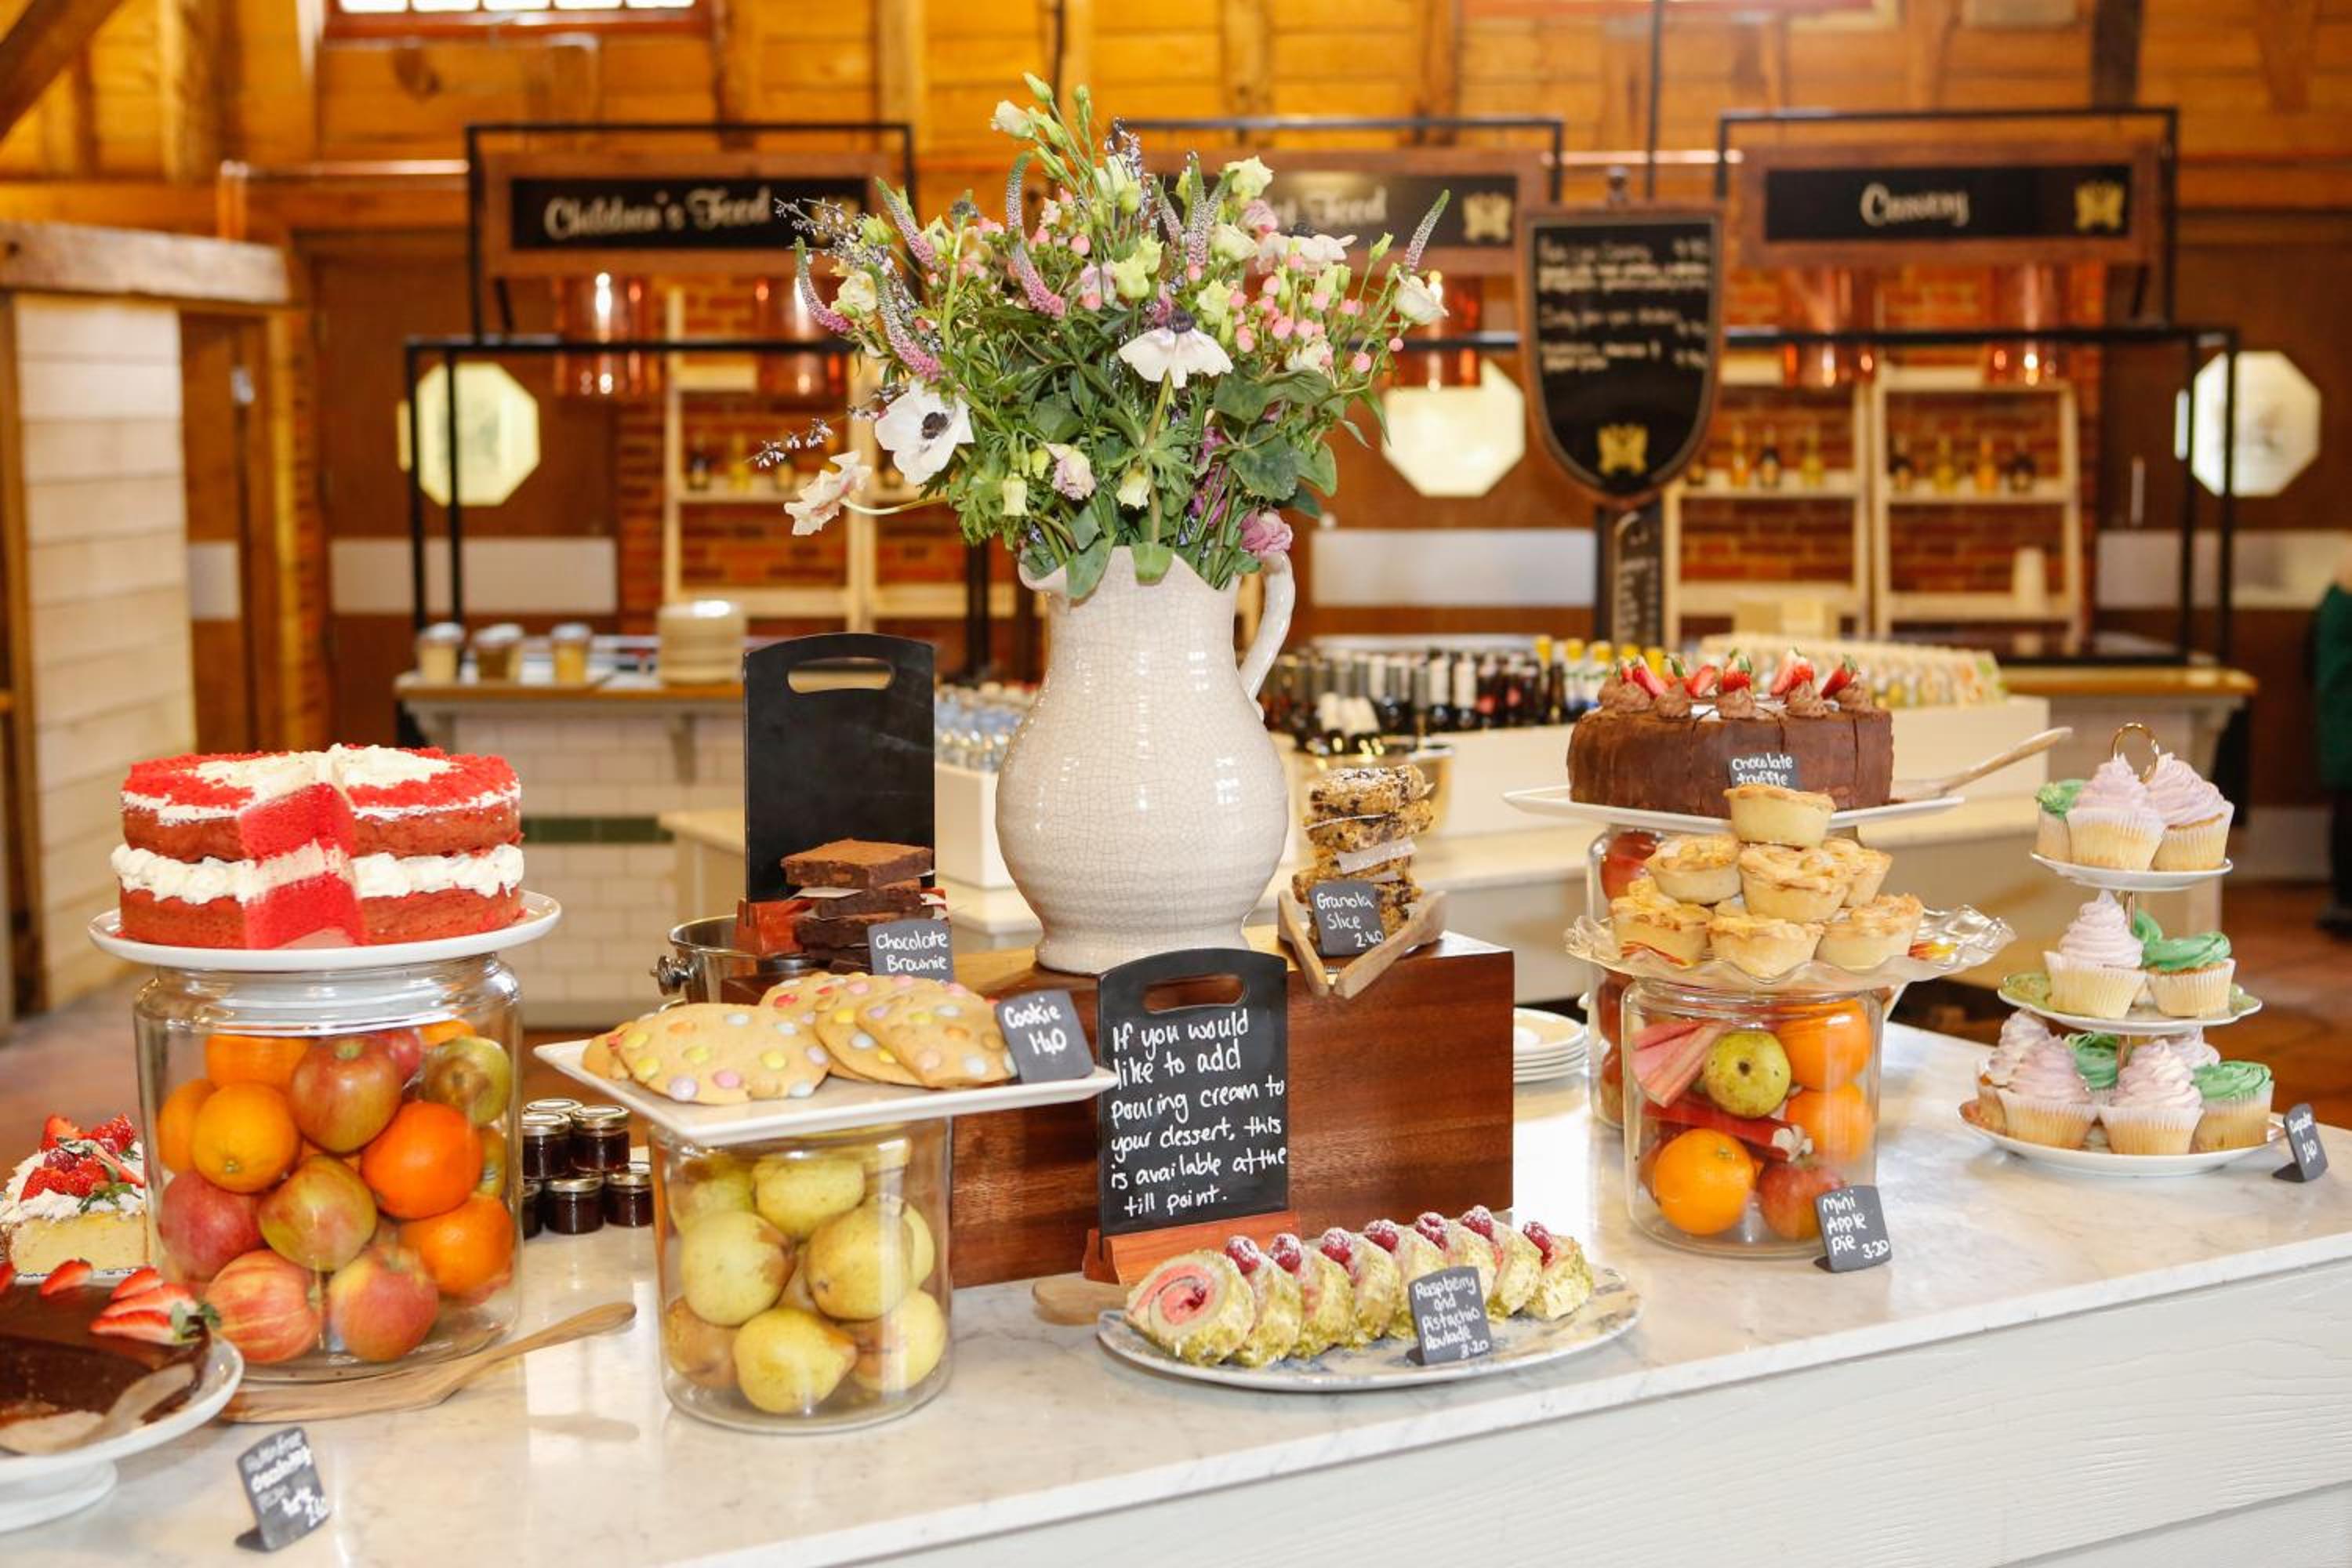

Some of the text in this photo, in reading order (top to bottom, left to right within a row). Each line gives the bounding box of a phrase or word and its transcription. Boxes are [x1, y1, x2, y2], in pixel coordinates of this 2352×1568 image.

[1732, 753, 1793, 771] Chocolate
[1317, 891, 1374, 910] Granola
[1327, 912, 1361, 929] Slice
[876, 930, 948, 950] Chocolate
[1354, 931, 1383, 948] 2.40
[887, 954, 947, 972] Brownie
[1004, 997, 1062, 1029] Cookie
[1112, 1007, 1249, 1061] If you would
[1113, 1037, 1241, 1090] like to add
[1200, 1083, 1258, 1108] cream
[1265, 1074, 1285, 1097] to
[1111, 1116, 1282, 1163] your dessert, this
[1111, 1164, 1128, 1190] is
[1136, 1152, 1221, 1185] available
[1124, 1184, 1228, 1217] till point.
[1827, 1213, 1867, 1235] Apple
[1415, 1276, 1476, 1301] Raspberry
[1434, 1293, 1457, 1311] and
